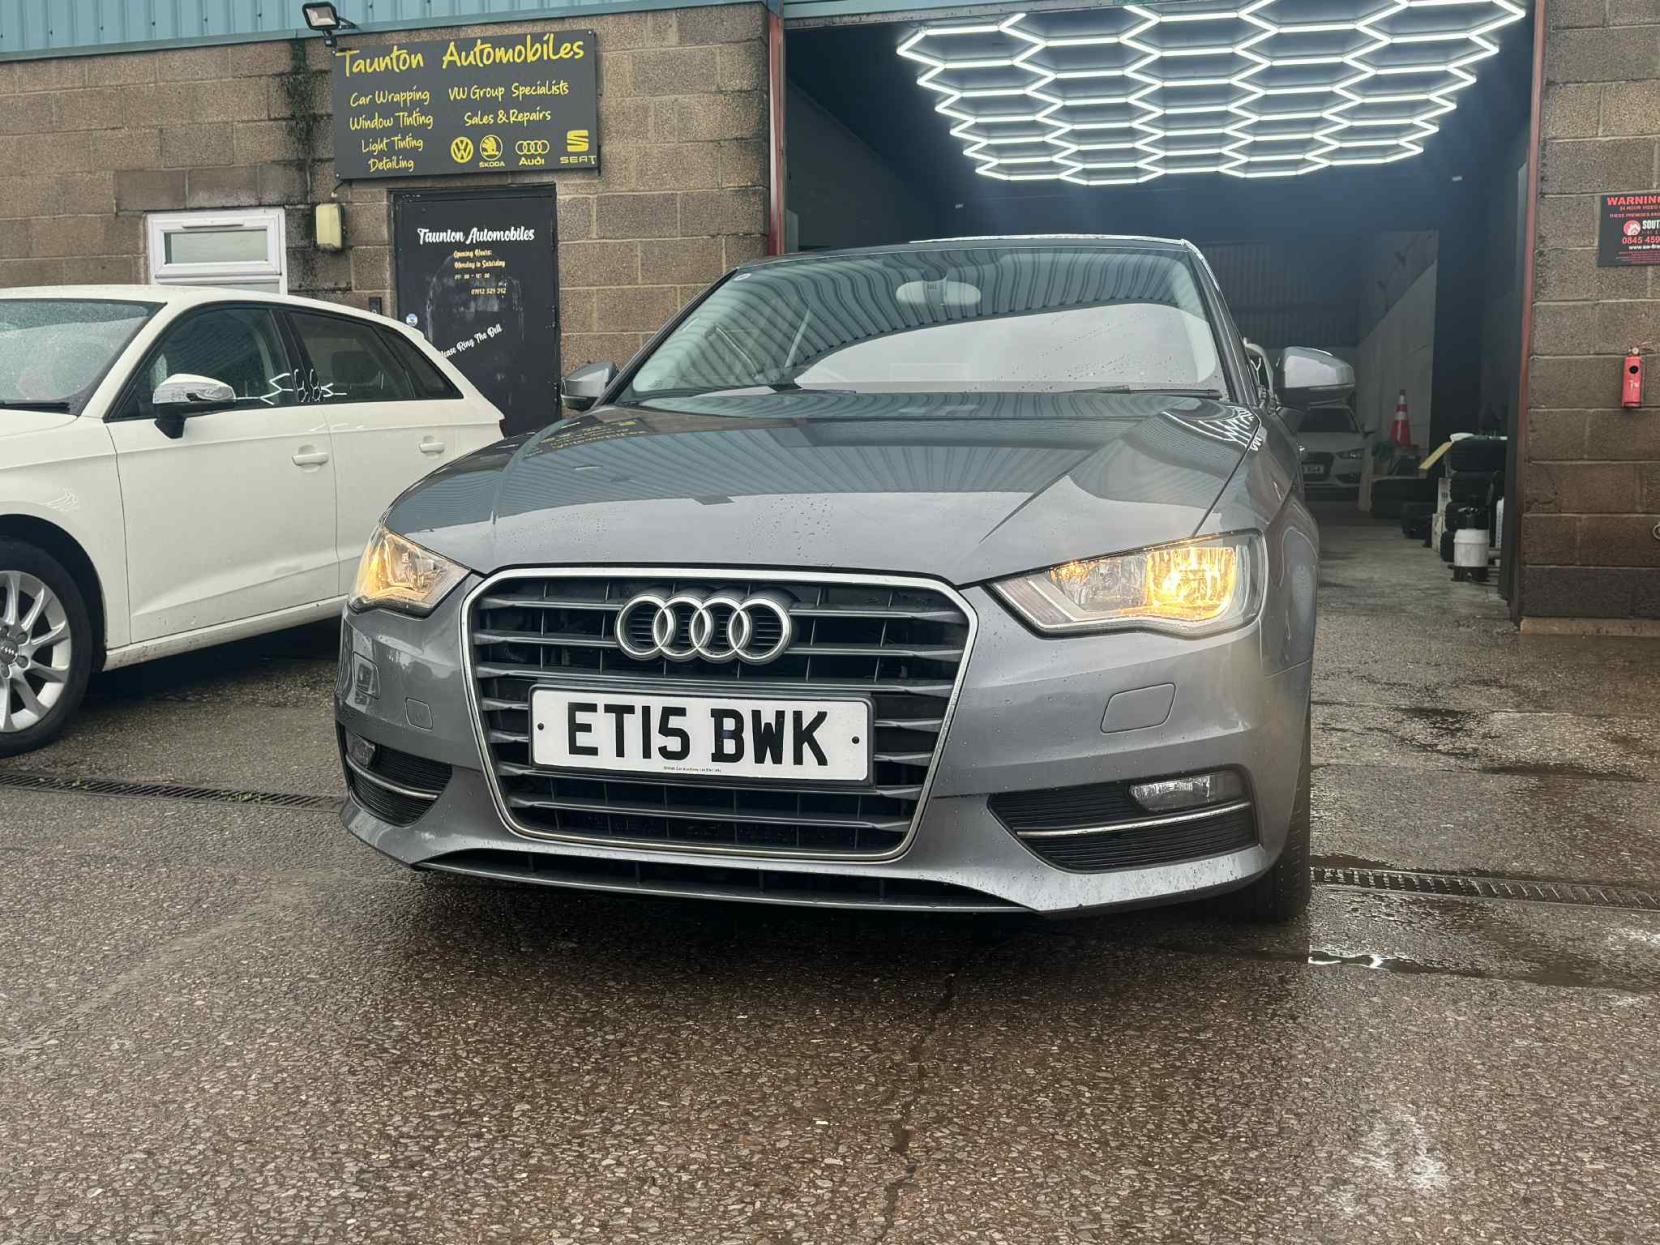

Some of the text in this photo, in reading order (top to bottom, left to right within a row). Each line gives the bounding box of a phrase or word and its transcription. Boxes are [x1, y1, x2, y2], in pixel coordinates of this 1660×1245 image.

[335, 33, 585, 77] Taunton Automobiles
[349, 85, 430, 107] Car Wrapping
[449, 80, 569, 102] VW Group Specialists
[349, 107, 433, 131] Window Tinting
[464, 106, 552, 127] Sales & Repairs
[361, 133, 424, 155] Light Tinting
[368, 155, 414, 172] Detailing
[519, 157, 545, 166] Audi
[560, 155, 597, 165] SEAT
[1607, 195, 1660, 206] WARNIN
[417, 226, 535, 245] Taunton Automobiles
[1622, 236, 1643, 244] 0845
[440, 323, 503, 359] lease Ring The Bell
[567, 701, 828, 767] ET15 BWK
